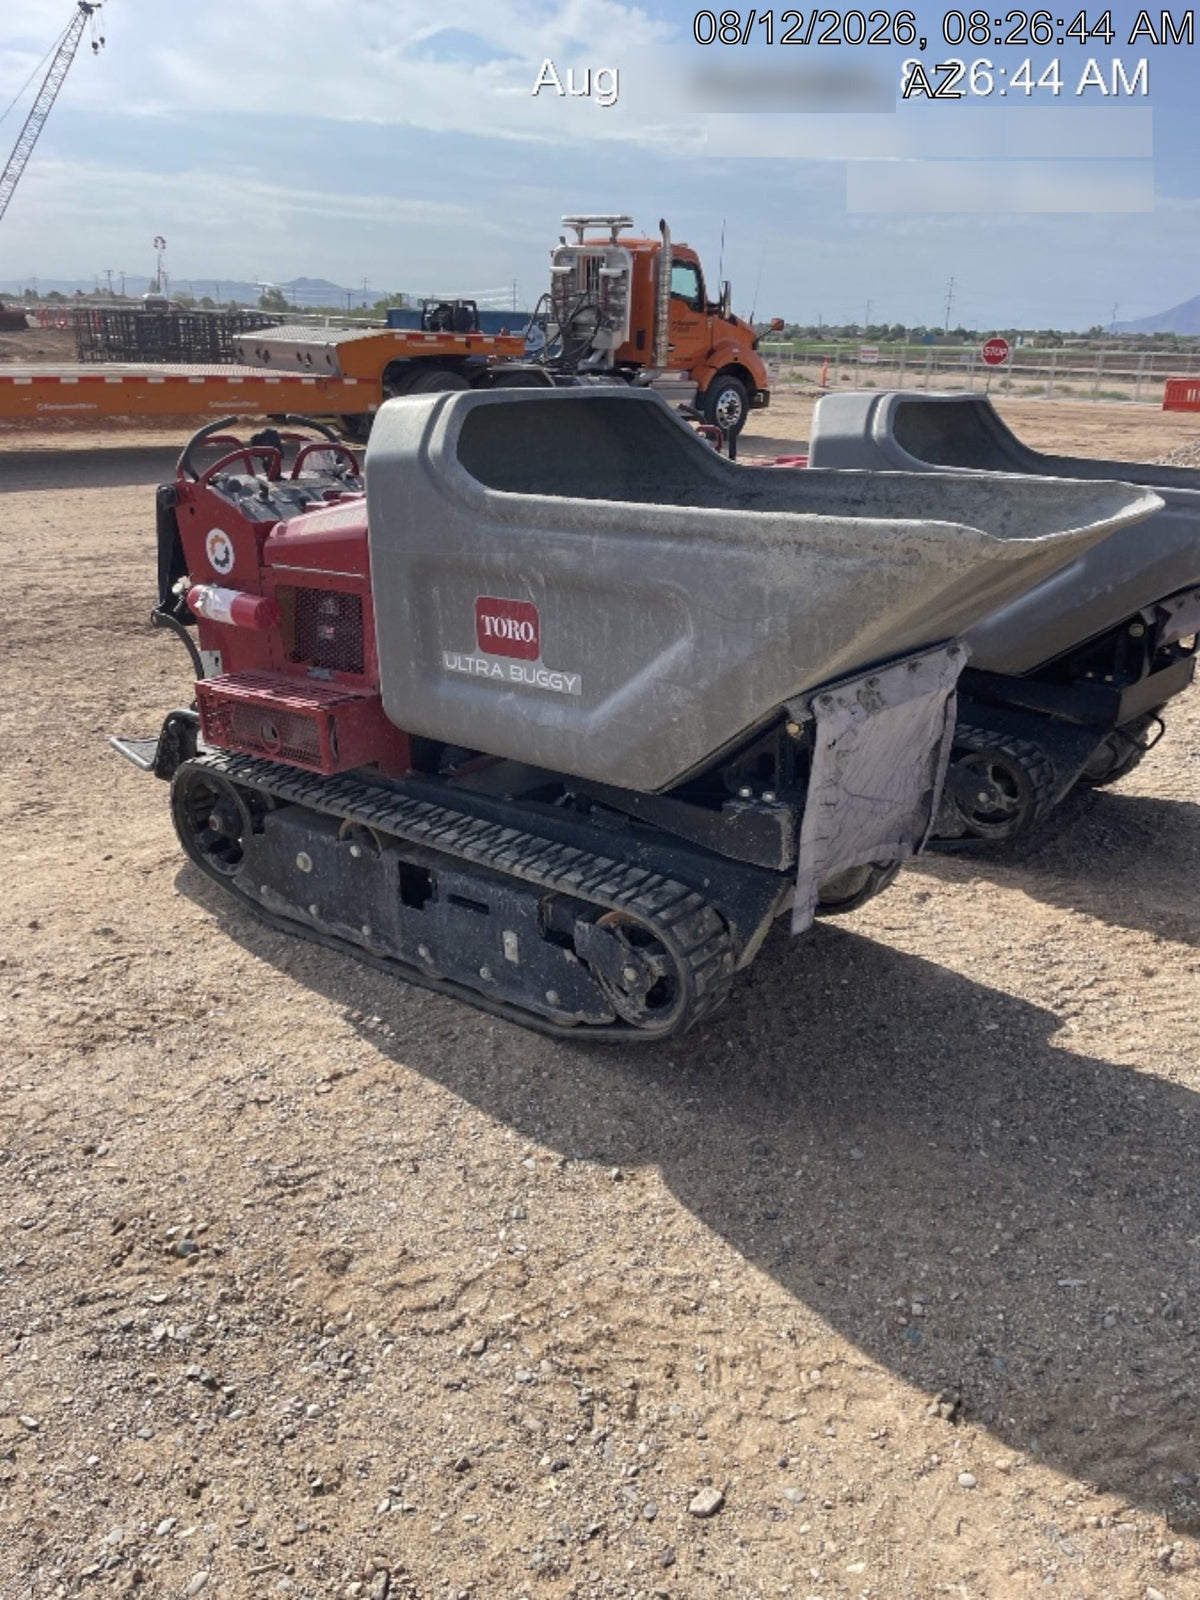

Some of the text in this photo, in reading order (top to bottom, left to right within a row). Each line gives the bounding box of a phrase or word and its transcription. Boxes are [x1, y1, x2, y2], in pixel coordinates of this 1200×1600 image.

[984, 346, 1007, 357] STOP
[481, 614, 535, 644] TORO
[444, 654, 577, 692] ULTRA BUGGY
